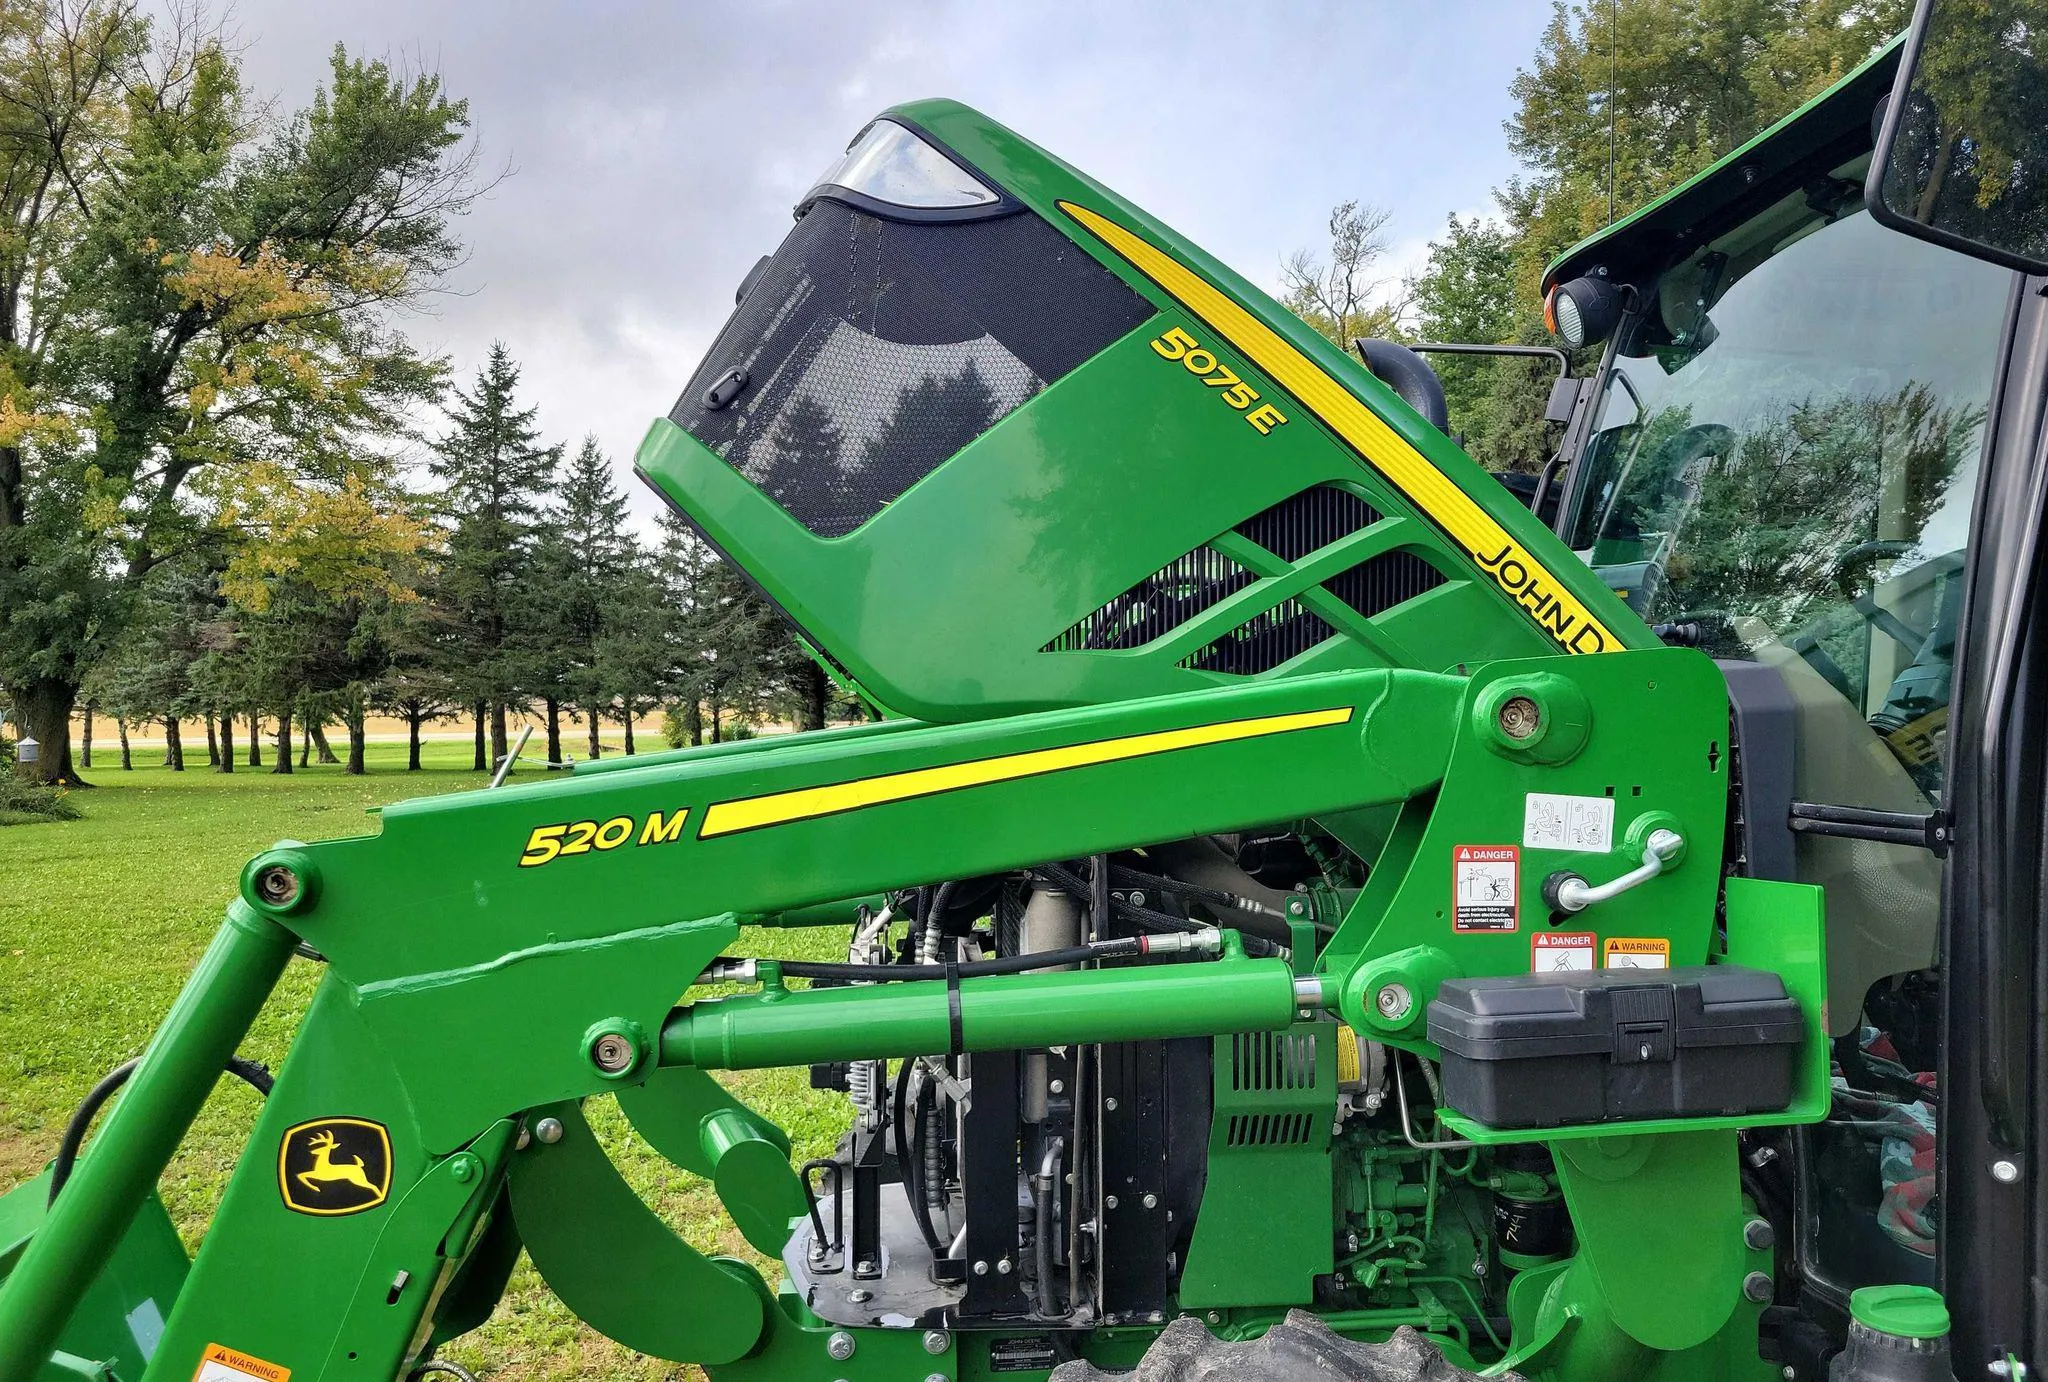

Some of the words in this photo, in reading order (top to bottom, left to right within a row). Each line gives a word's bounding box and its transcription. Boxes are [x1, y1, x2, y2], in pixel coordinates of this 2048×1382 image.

[1149, 325, 1261, 411] 5075
[1244, 403, 1289, 437] E
[1476, 544, 1576, 636] JOHN
[518, 815, 635, 868] 520
[636, 807, 692, 847] M
[1473, 850, 1514, 859] DANGER
[1551, 936, 1591, 945] DANGER
[1621, 942, 1666, 951] WARNING
[1506, 1214, 1528, 1242] 744
[229, 1355, 280, 1379] WARNING
